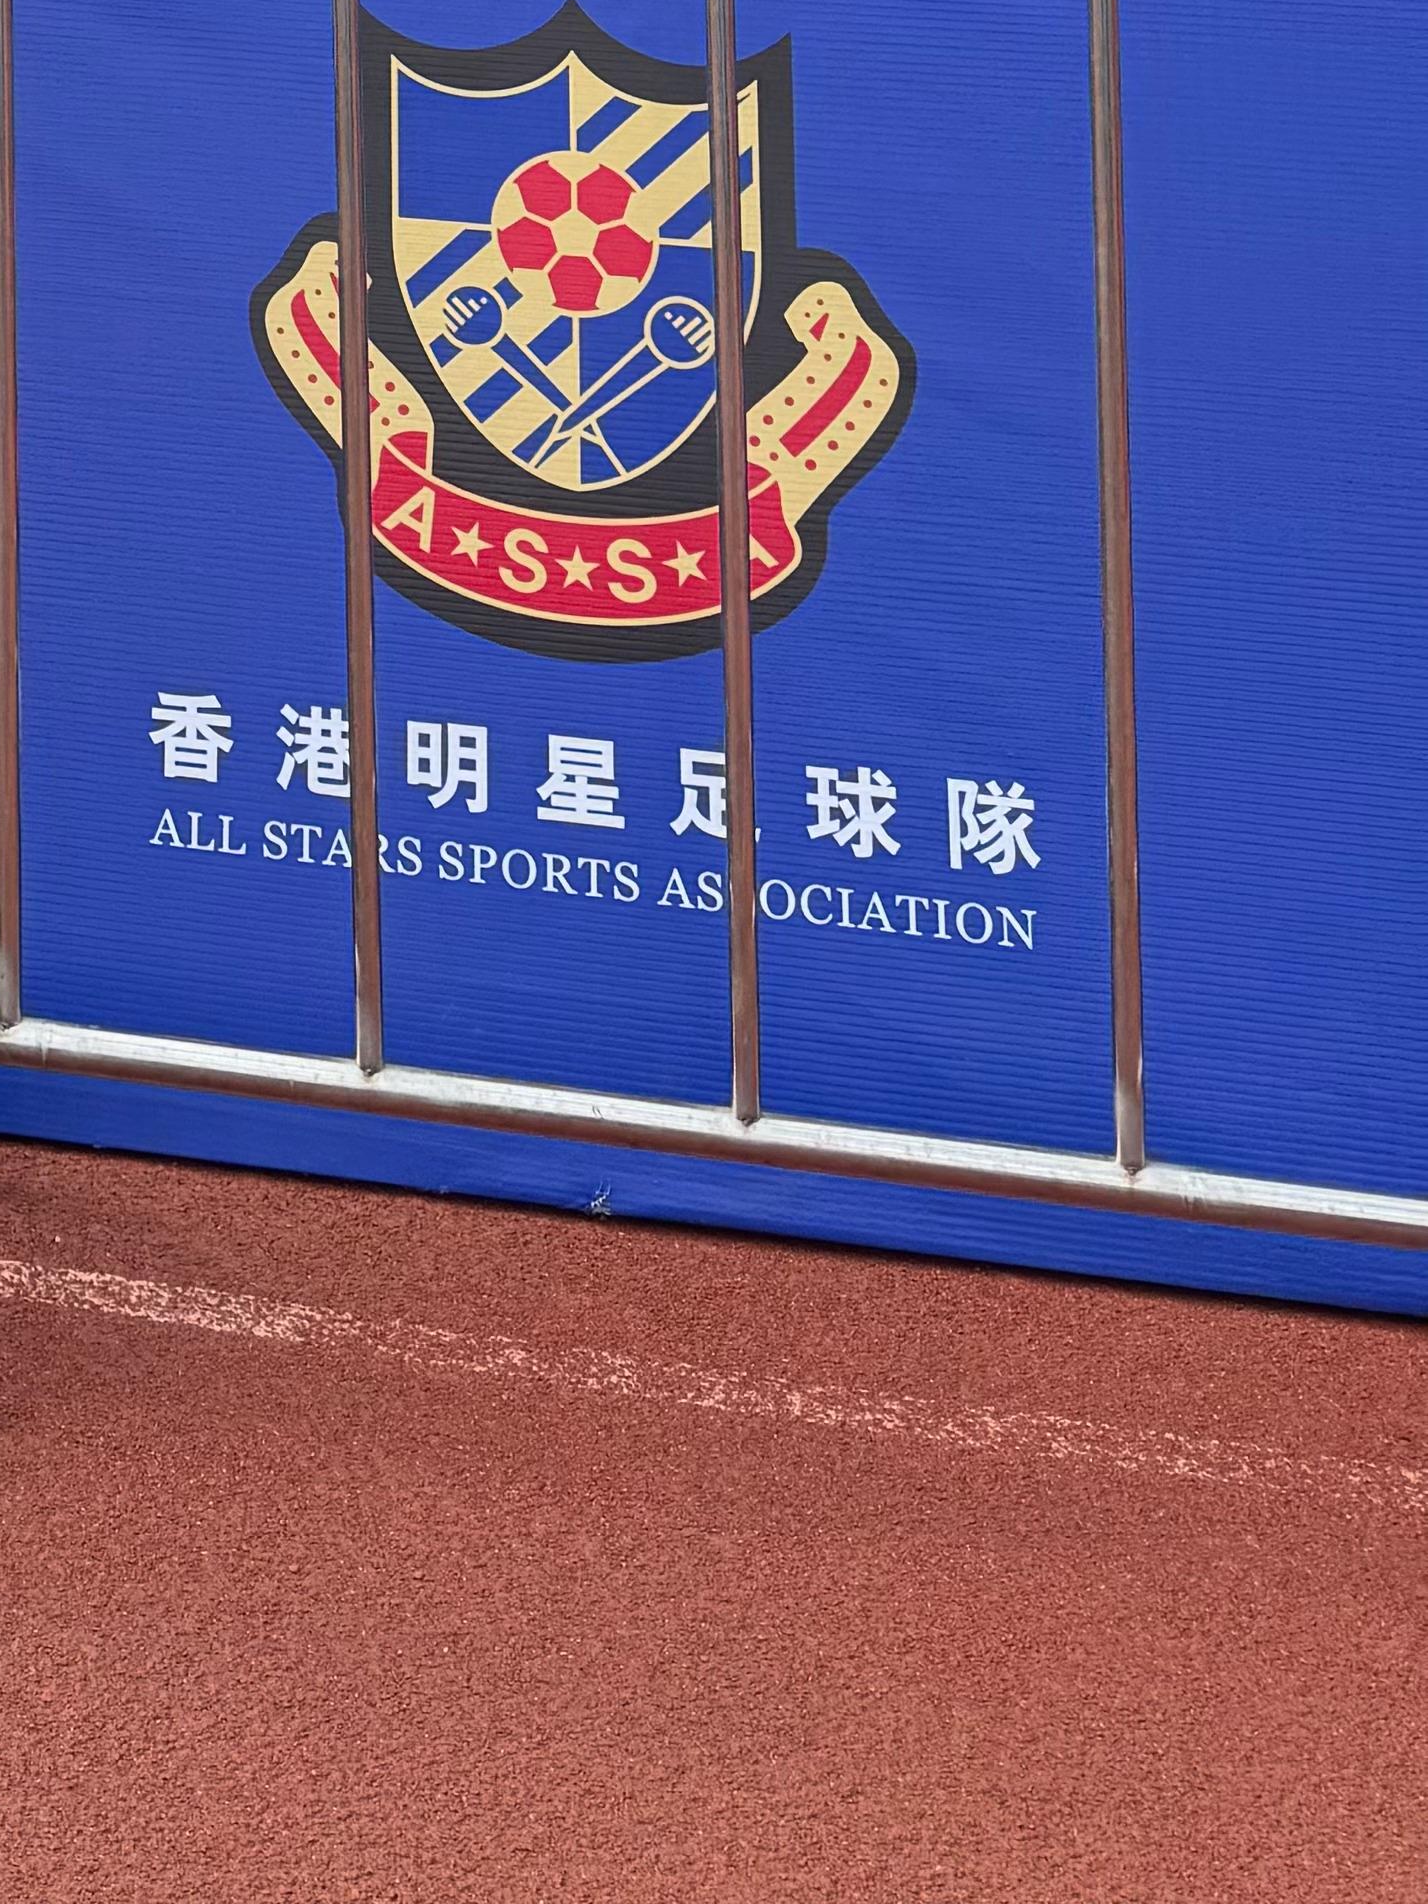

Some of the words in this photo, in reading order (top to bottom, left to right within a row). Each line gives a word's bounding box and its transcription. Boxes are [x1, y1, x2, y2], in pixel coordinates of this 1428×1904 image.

[148, 691, 1042, 875] 香港明星足球隊
[149, 807, 247, 855] ALL
[438, 840, 641, 903] SPORTS
[656, 867, 1038, 950] ASOCIATION
